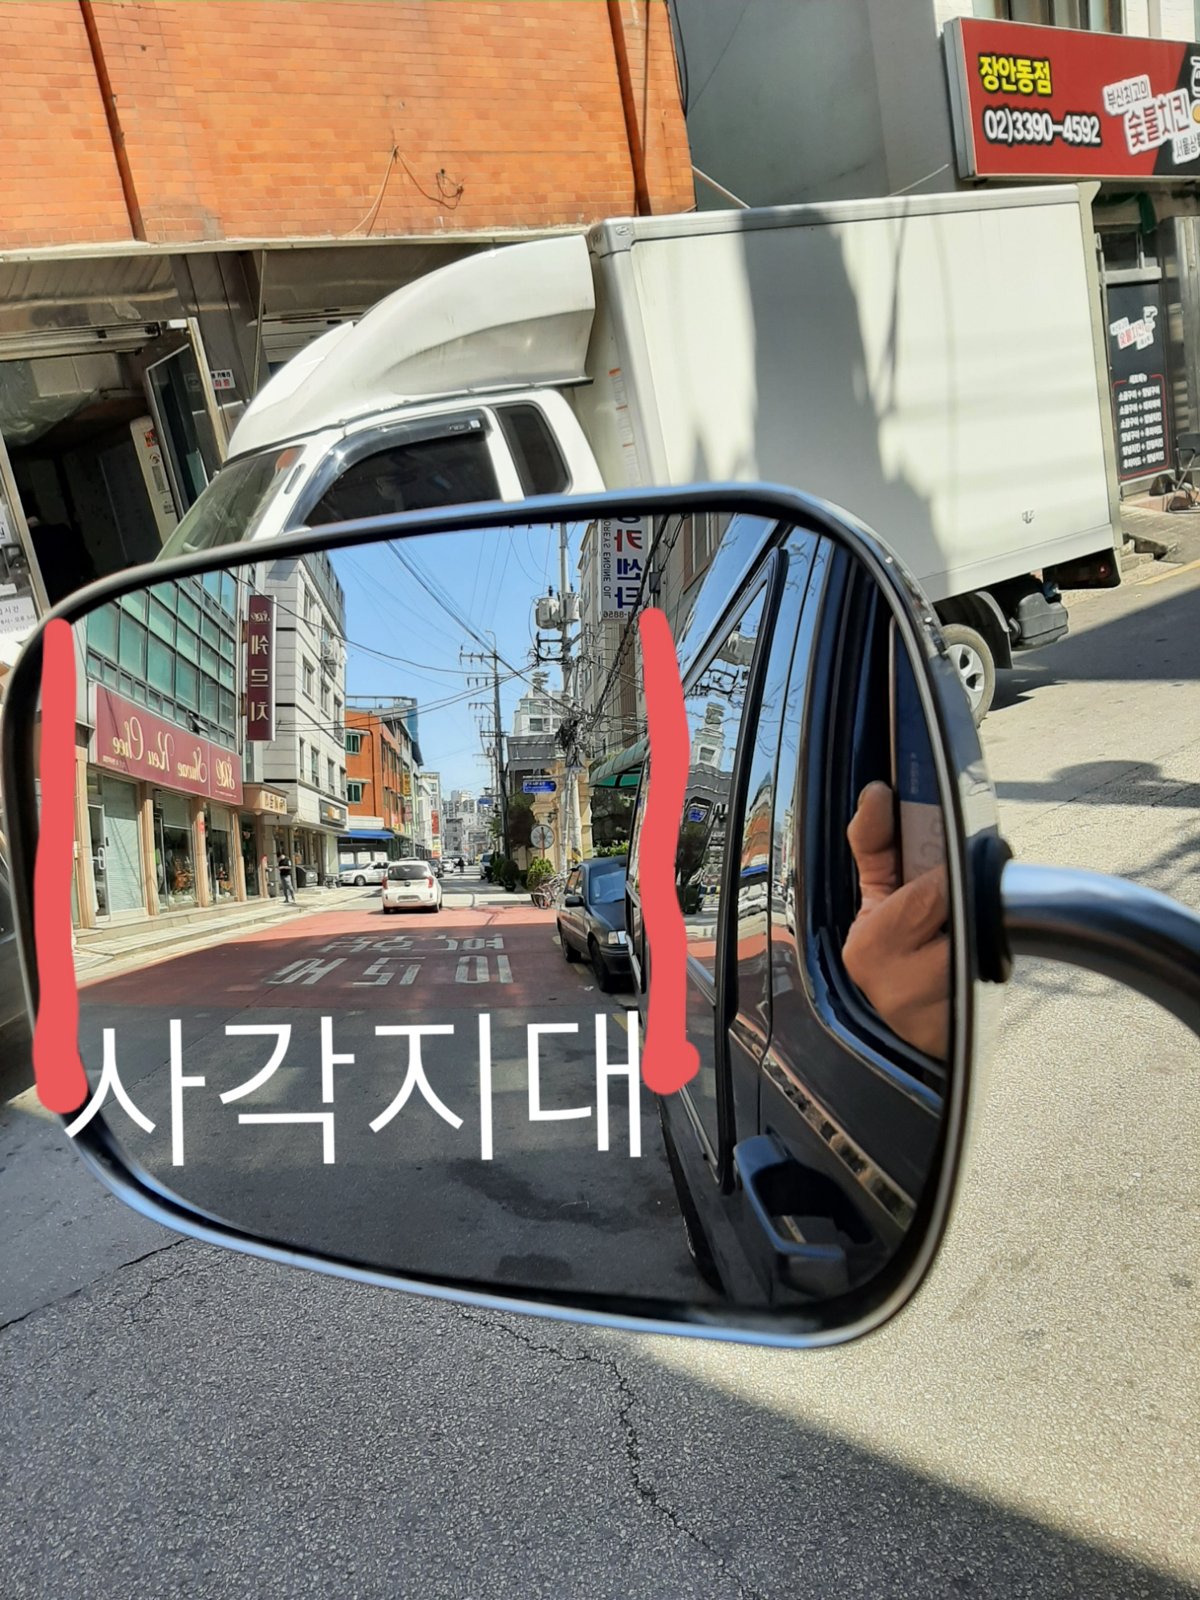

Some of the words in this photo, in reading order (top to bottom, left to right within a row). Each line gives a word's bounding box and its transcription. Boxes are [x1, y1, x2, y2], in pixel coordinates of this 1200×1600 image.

[979, 55, 1052, 94] 장안동점
[1107, 79, 1149, 108] 부산최고의
[984, 107, 1101, 143] 02)3390-4592
[1128, 93, 1190, 147] 숯불치킨
[1176, 132, 1200, 157] 서울상
